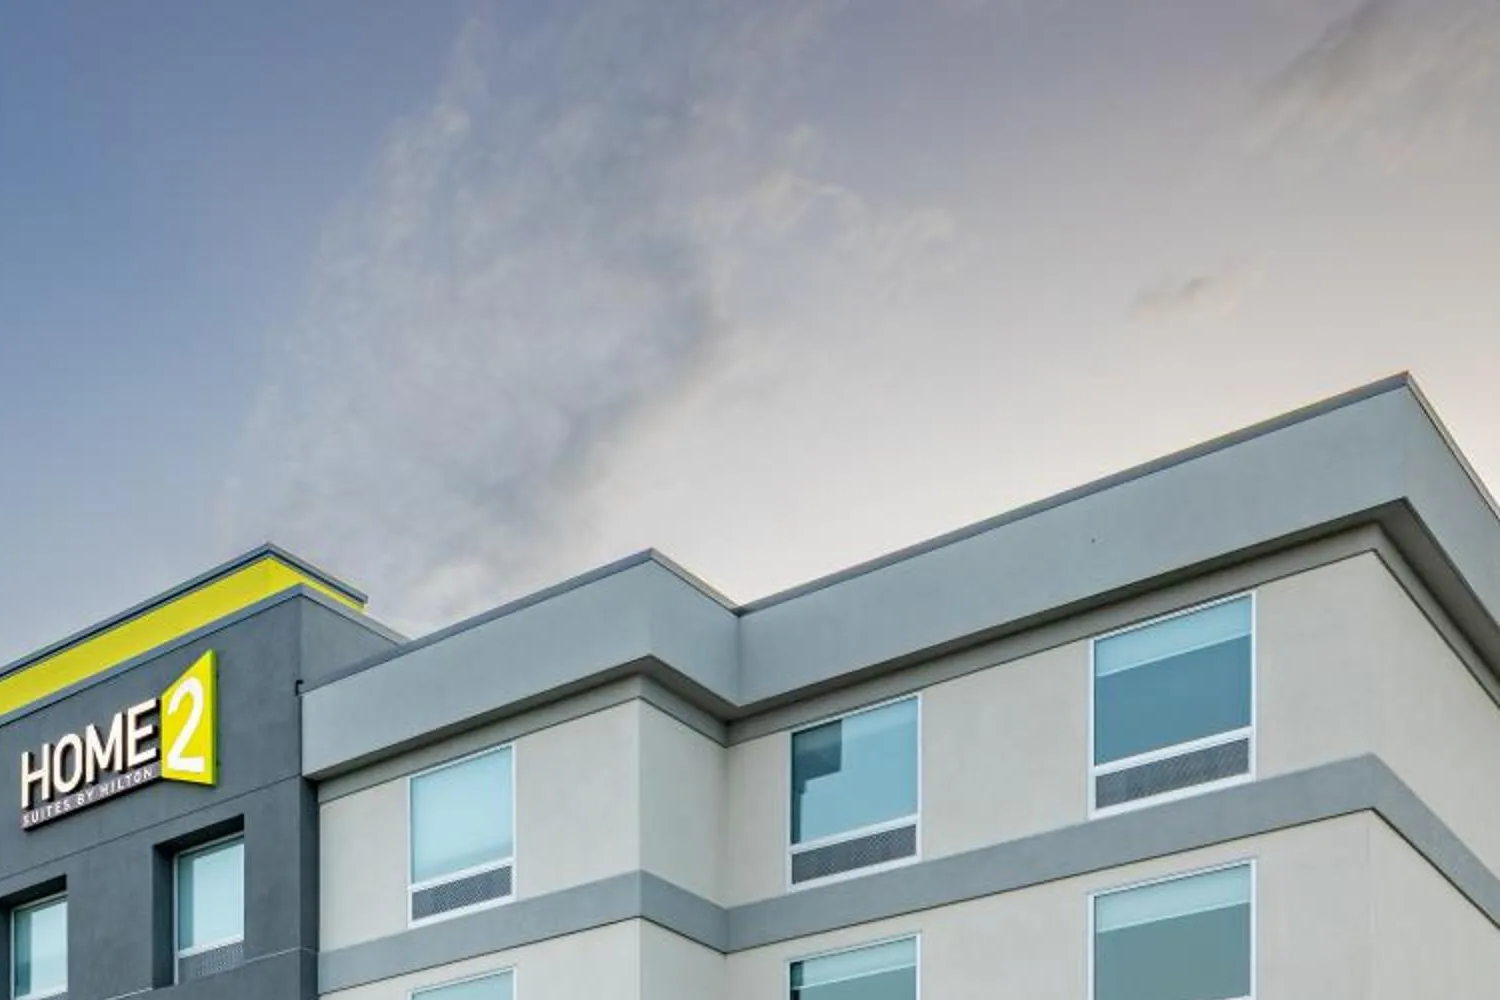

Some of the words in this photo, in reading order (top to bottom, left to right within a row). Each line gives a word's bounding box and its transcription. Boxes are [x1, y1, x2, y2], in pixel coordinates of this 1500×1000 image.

[21, 698, 157, 809] HOME
[22, 799, 71, 826] SUITES
[77, 787, 94, 806] BY
[99, 767, 153, 797] HILTON
